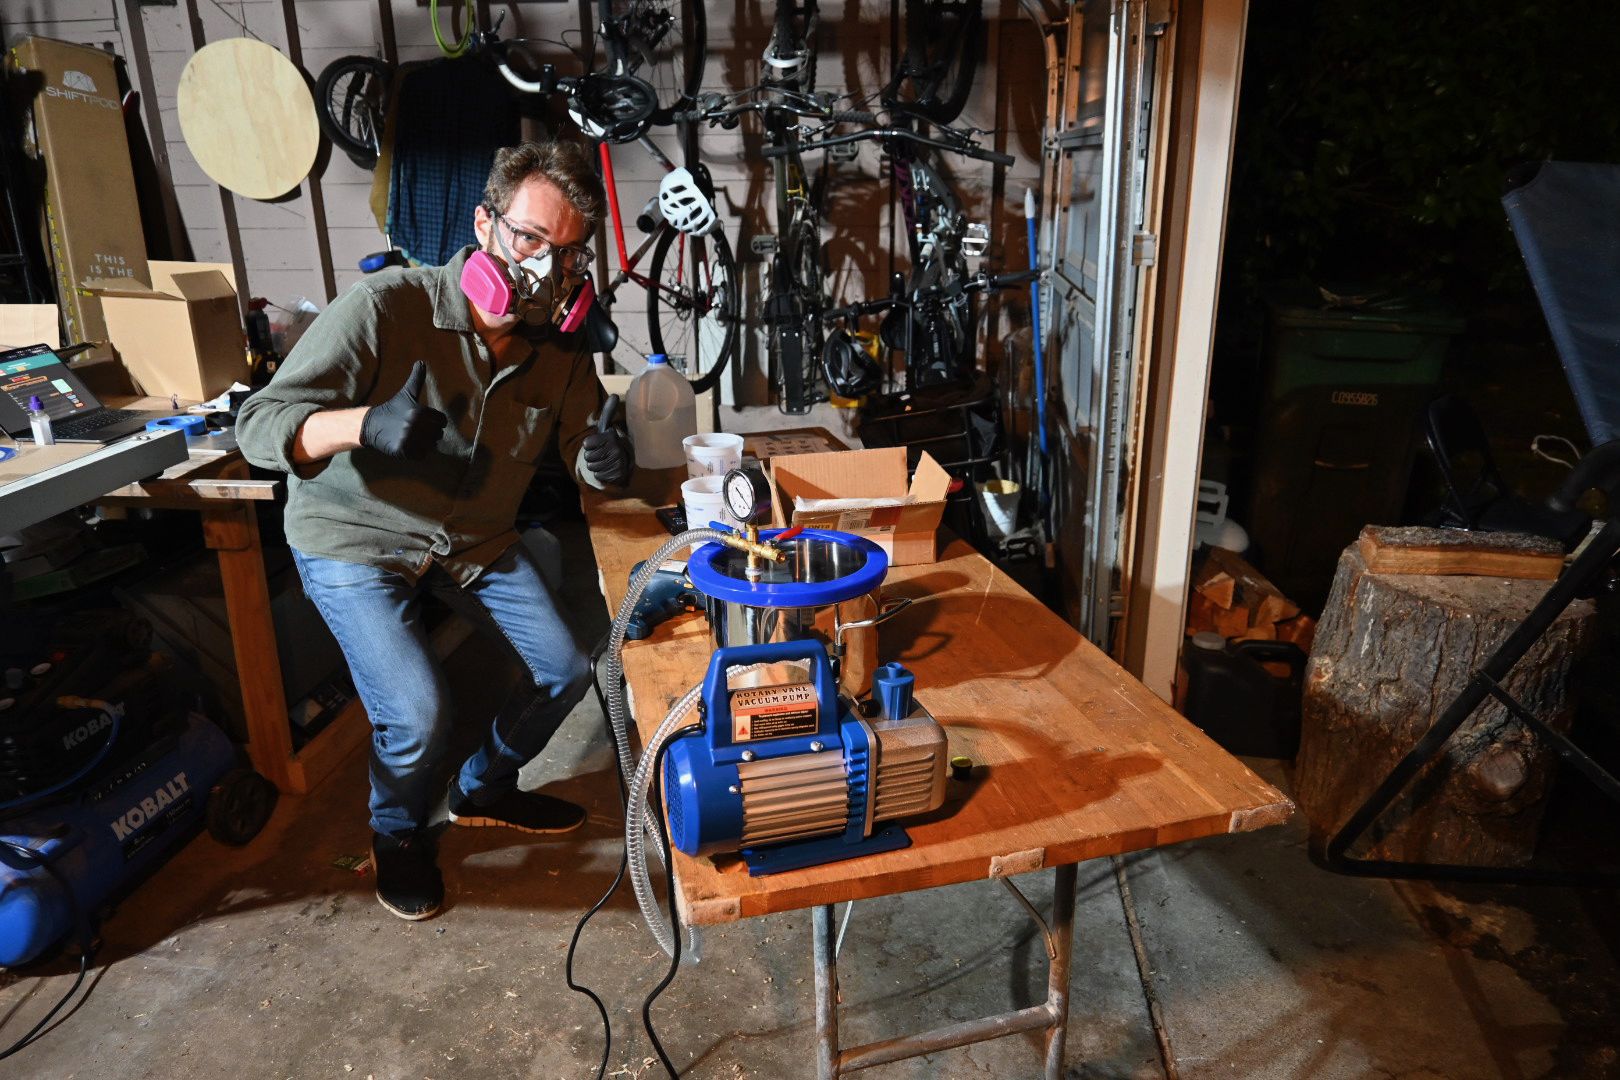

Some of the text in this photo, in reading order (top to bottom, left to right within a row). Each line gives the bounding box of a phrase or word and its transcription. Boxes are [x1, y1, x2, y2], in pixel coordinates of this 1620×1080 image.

[45, 86, 120, 110] SHIFTPOD
[95, 253, 126, 265] THIS
[89, 264, 134, 278] IS THE
[736, 689, 777, 699] ROTARY
[737, 693, 810, 707] VACUUM PUMP
[62, 701, 126, 751] KOBAT
[110, 771, 189, 842] KOBALT
